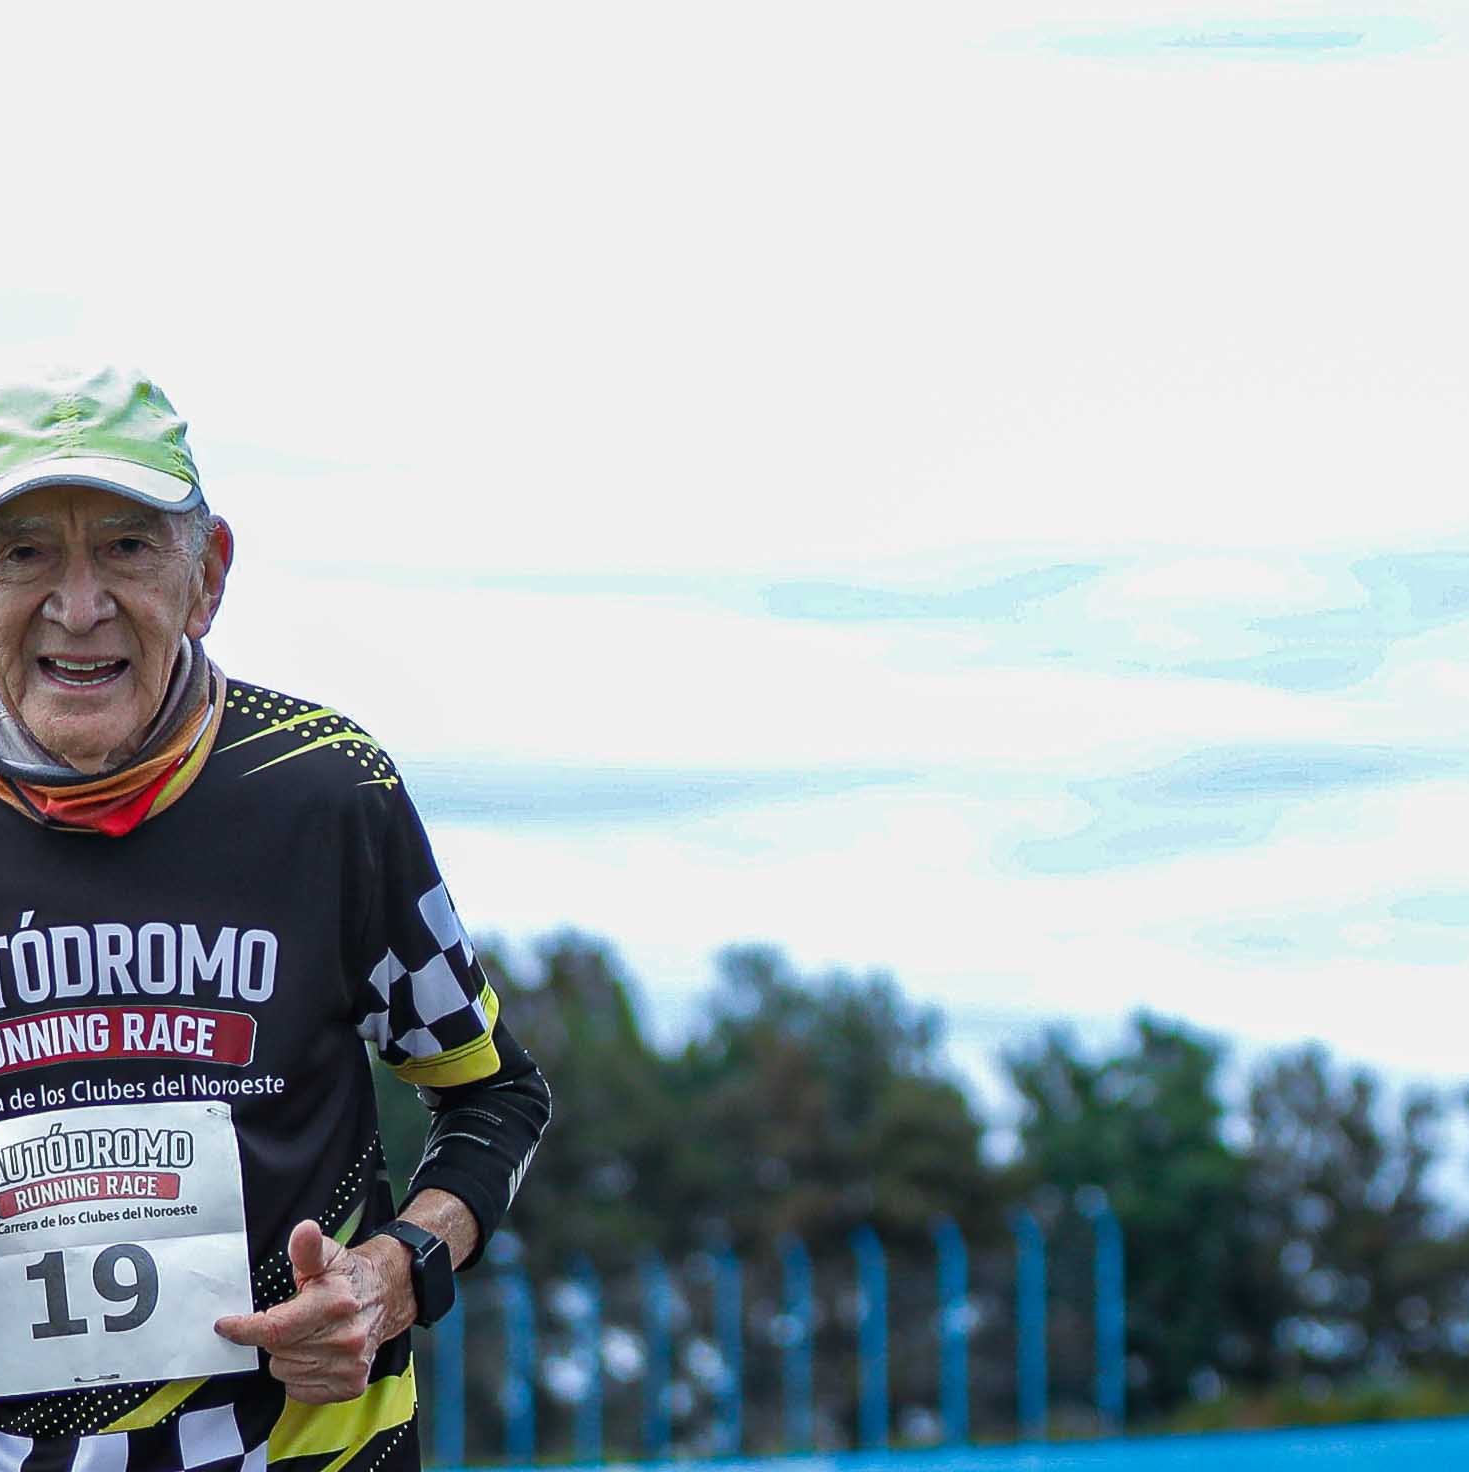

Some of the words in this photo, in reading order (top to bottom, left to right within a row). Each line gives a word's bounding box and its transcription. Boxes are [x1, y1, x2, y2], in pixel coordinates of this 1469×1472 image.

[122, 1012, 217, 1058] RACE
[10, 1088, 36, 1110] de
[41, 1084, 66, 1107] los
[71, 1077, 146, 1102] Clubes
[152, 1073, 187, 1098] del
[192, 1073, 285, 1096] Noroeste
[14, 1174, 100, 1212] RUNNING
[106, 1175, 159, 1197] RACE
[40, 1216, 56, 1229] de
[58, 1213, 76, 1226] los
[78, 1209, 120, 1223] Clubes
[122, 1207, 141, 1220] del
[144, 1203, 198, 1218] Noroeste
[26, 1243, 159, 1339] 19
